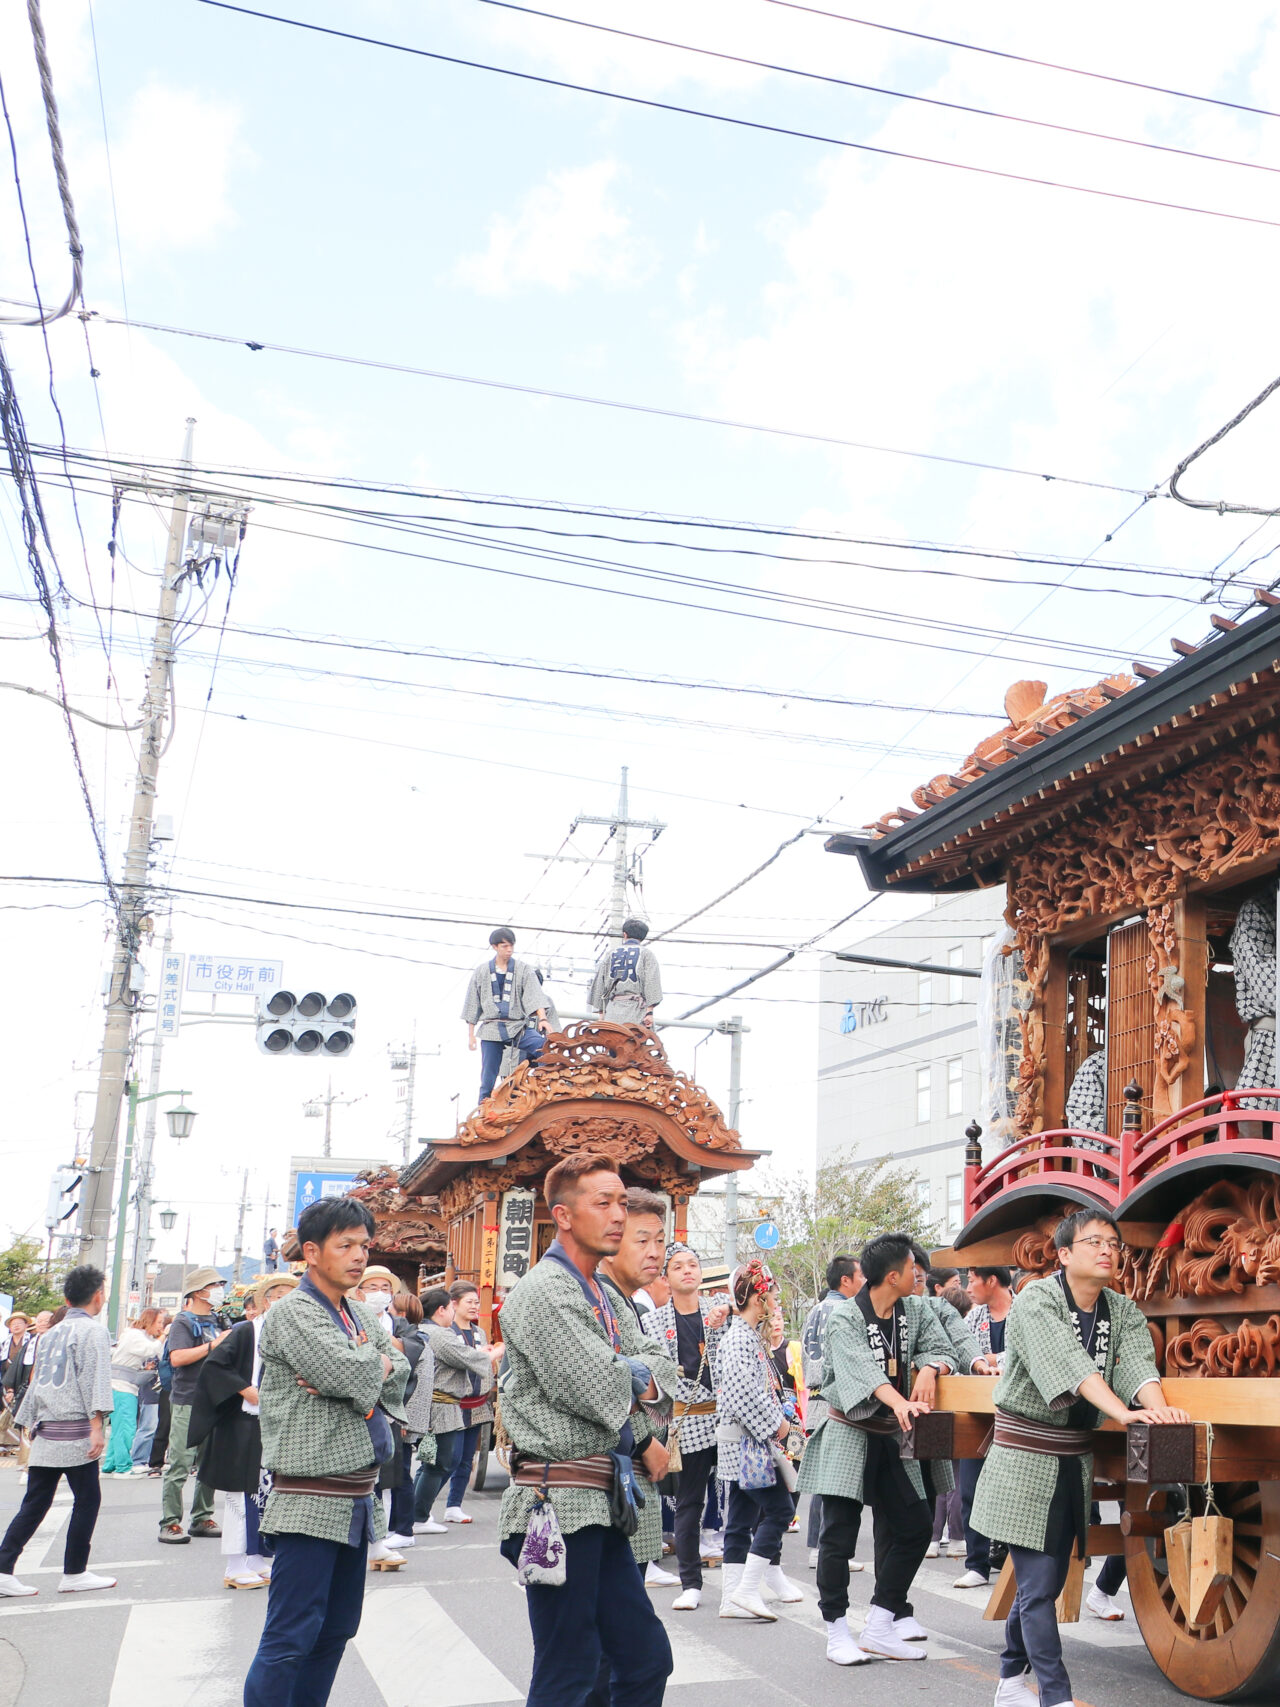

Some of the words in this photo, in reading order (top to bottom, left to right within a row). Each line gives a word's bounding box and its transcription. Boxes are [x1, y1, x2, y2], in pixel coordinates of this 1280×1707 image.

[195, 963, 275, 982] 市役所前
[610, 947, 641, 982] 朝
[162, 958, 180, 1032] 時差式信号
[214, 981, 233, 992] City
[236, 982, 255, 992] Hall
[855, 995, 889, 1027] TKC
[503, 1198, 533, 1278] 朝日町
[1128, 1431, 1148, 1471] 文
